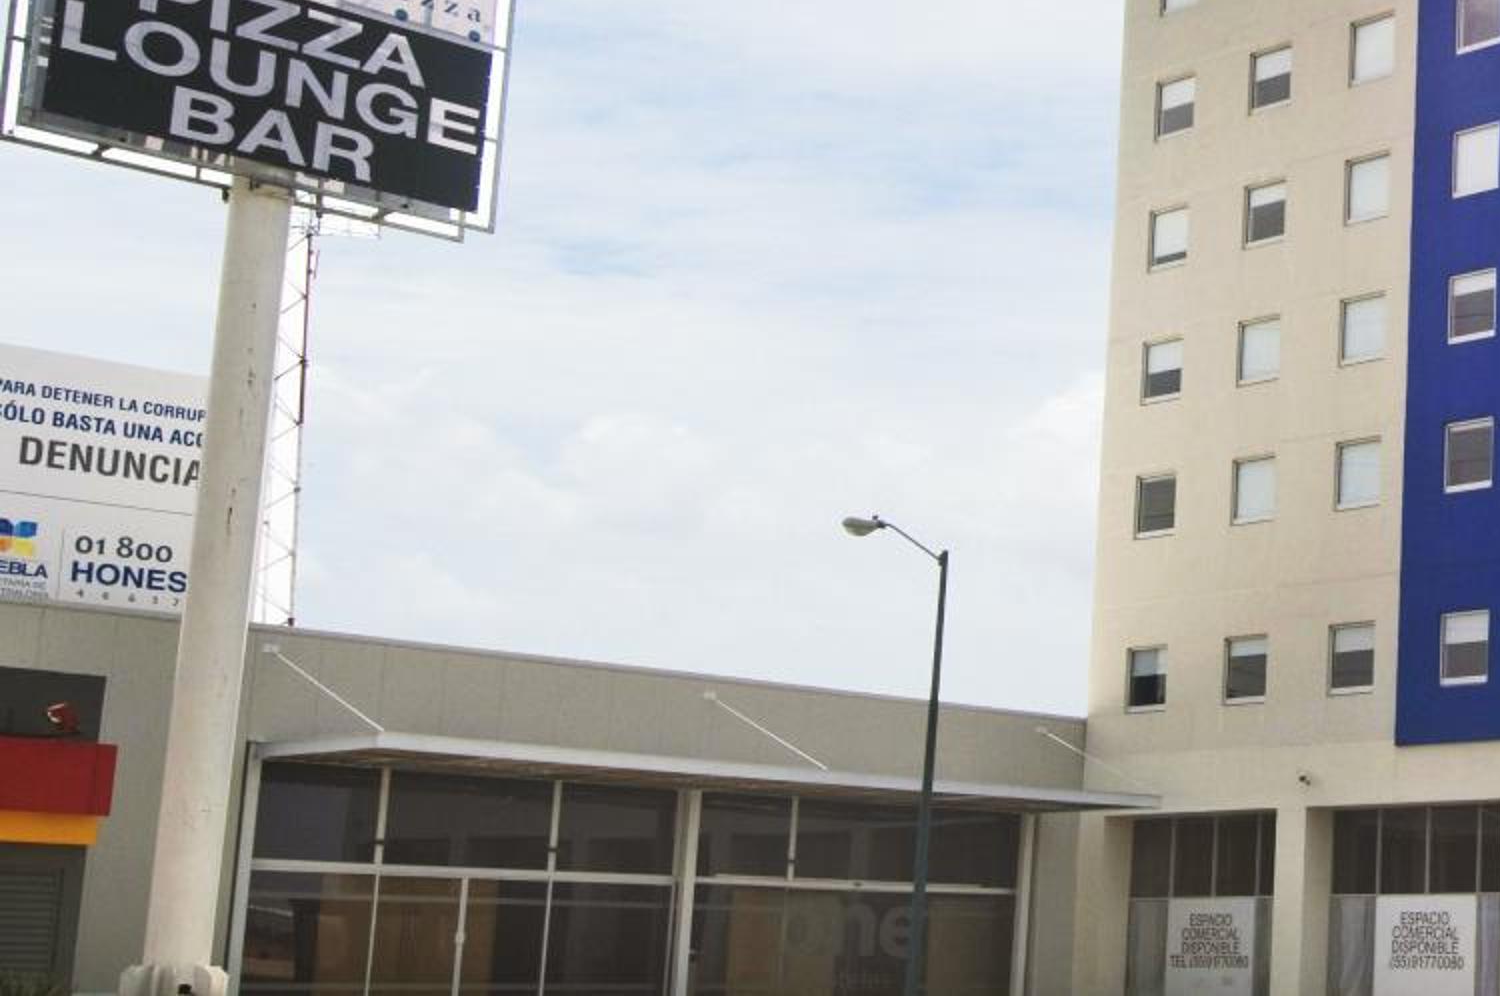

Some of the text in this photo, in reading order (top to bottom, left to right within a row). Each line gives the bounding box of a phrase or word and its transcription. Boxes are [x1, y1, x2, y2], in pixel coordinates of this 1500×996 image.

[170, 86, 374, 182] BAR
[0, 378, 36, 396] ARA
[41, 384, 114, 409] DETENER
[118, 397, 138, 413] LA
[0, 399, 45, 424] ÓLO
[52, 411, 117, 436] BASTA
[124, 421, 163, 443] UNA
[19, 435, 200, 486] DENUNCIA
[75, 535, 173, 563] 01 800
[1391, 925, 1460, 941] COMERCIAL
[1400, 911, 1450, 925] ESPACIO
[1391, 940, 1460, 955] DISPONIBLE
